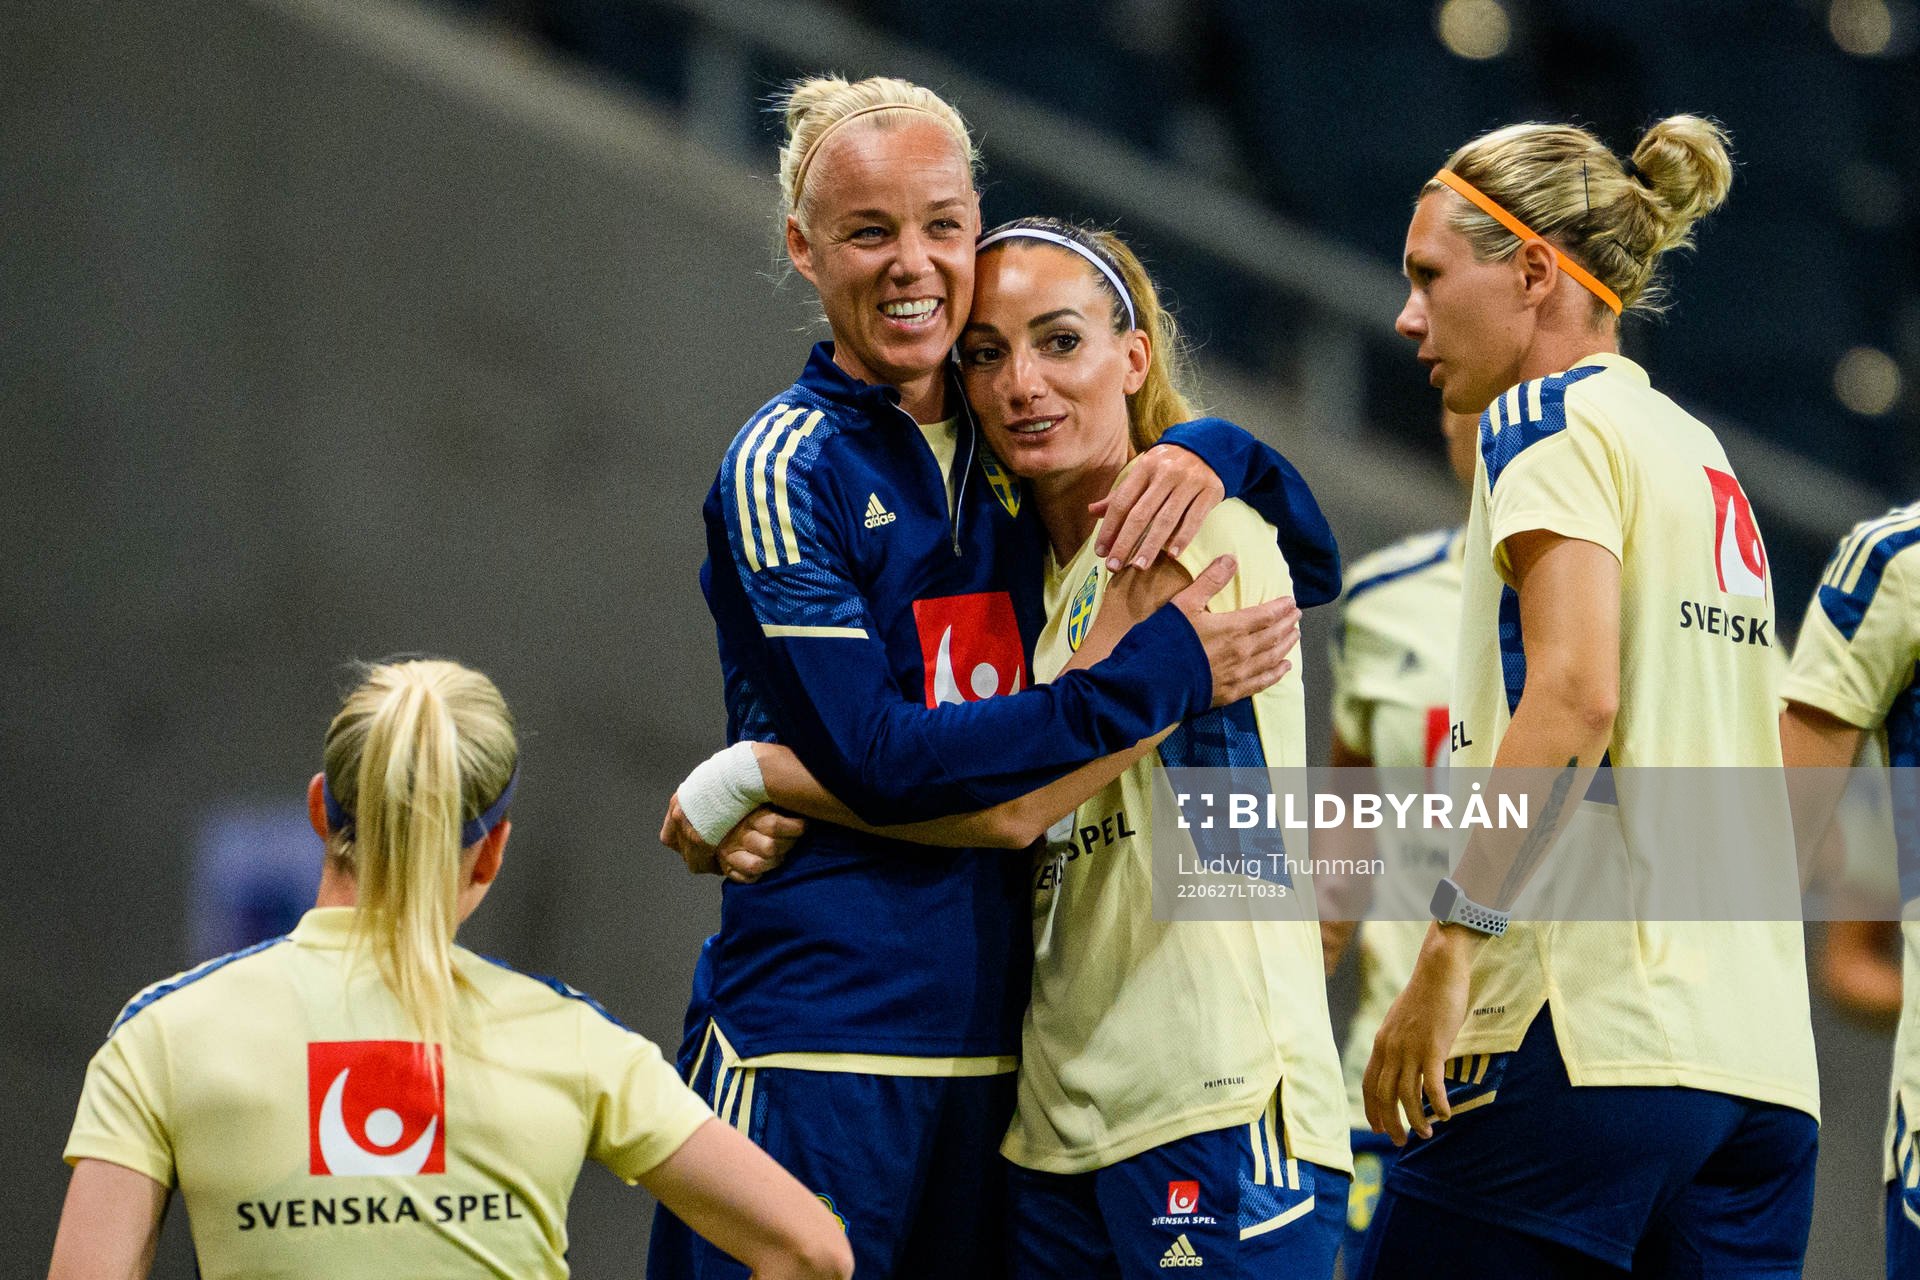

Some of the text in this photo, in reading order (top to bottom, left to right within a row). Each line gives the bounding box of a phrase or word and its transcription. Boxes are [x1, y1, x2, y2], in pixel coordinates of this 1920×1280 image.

[864, 511, 897, 529] adidas
[1680, 600, 1773, 648] SVENSK
[1204, 1076, 1245, 1090] PRIMEBLUE
[237, 1193, 523, 1231] SVENSKA SPEL
[1192, 1216, 1217, 1225] SPEL
[1160, 1255, 1203, 1268] adidas
